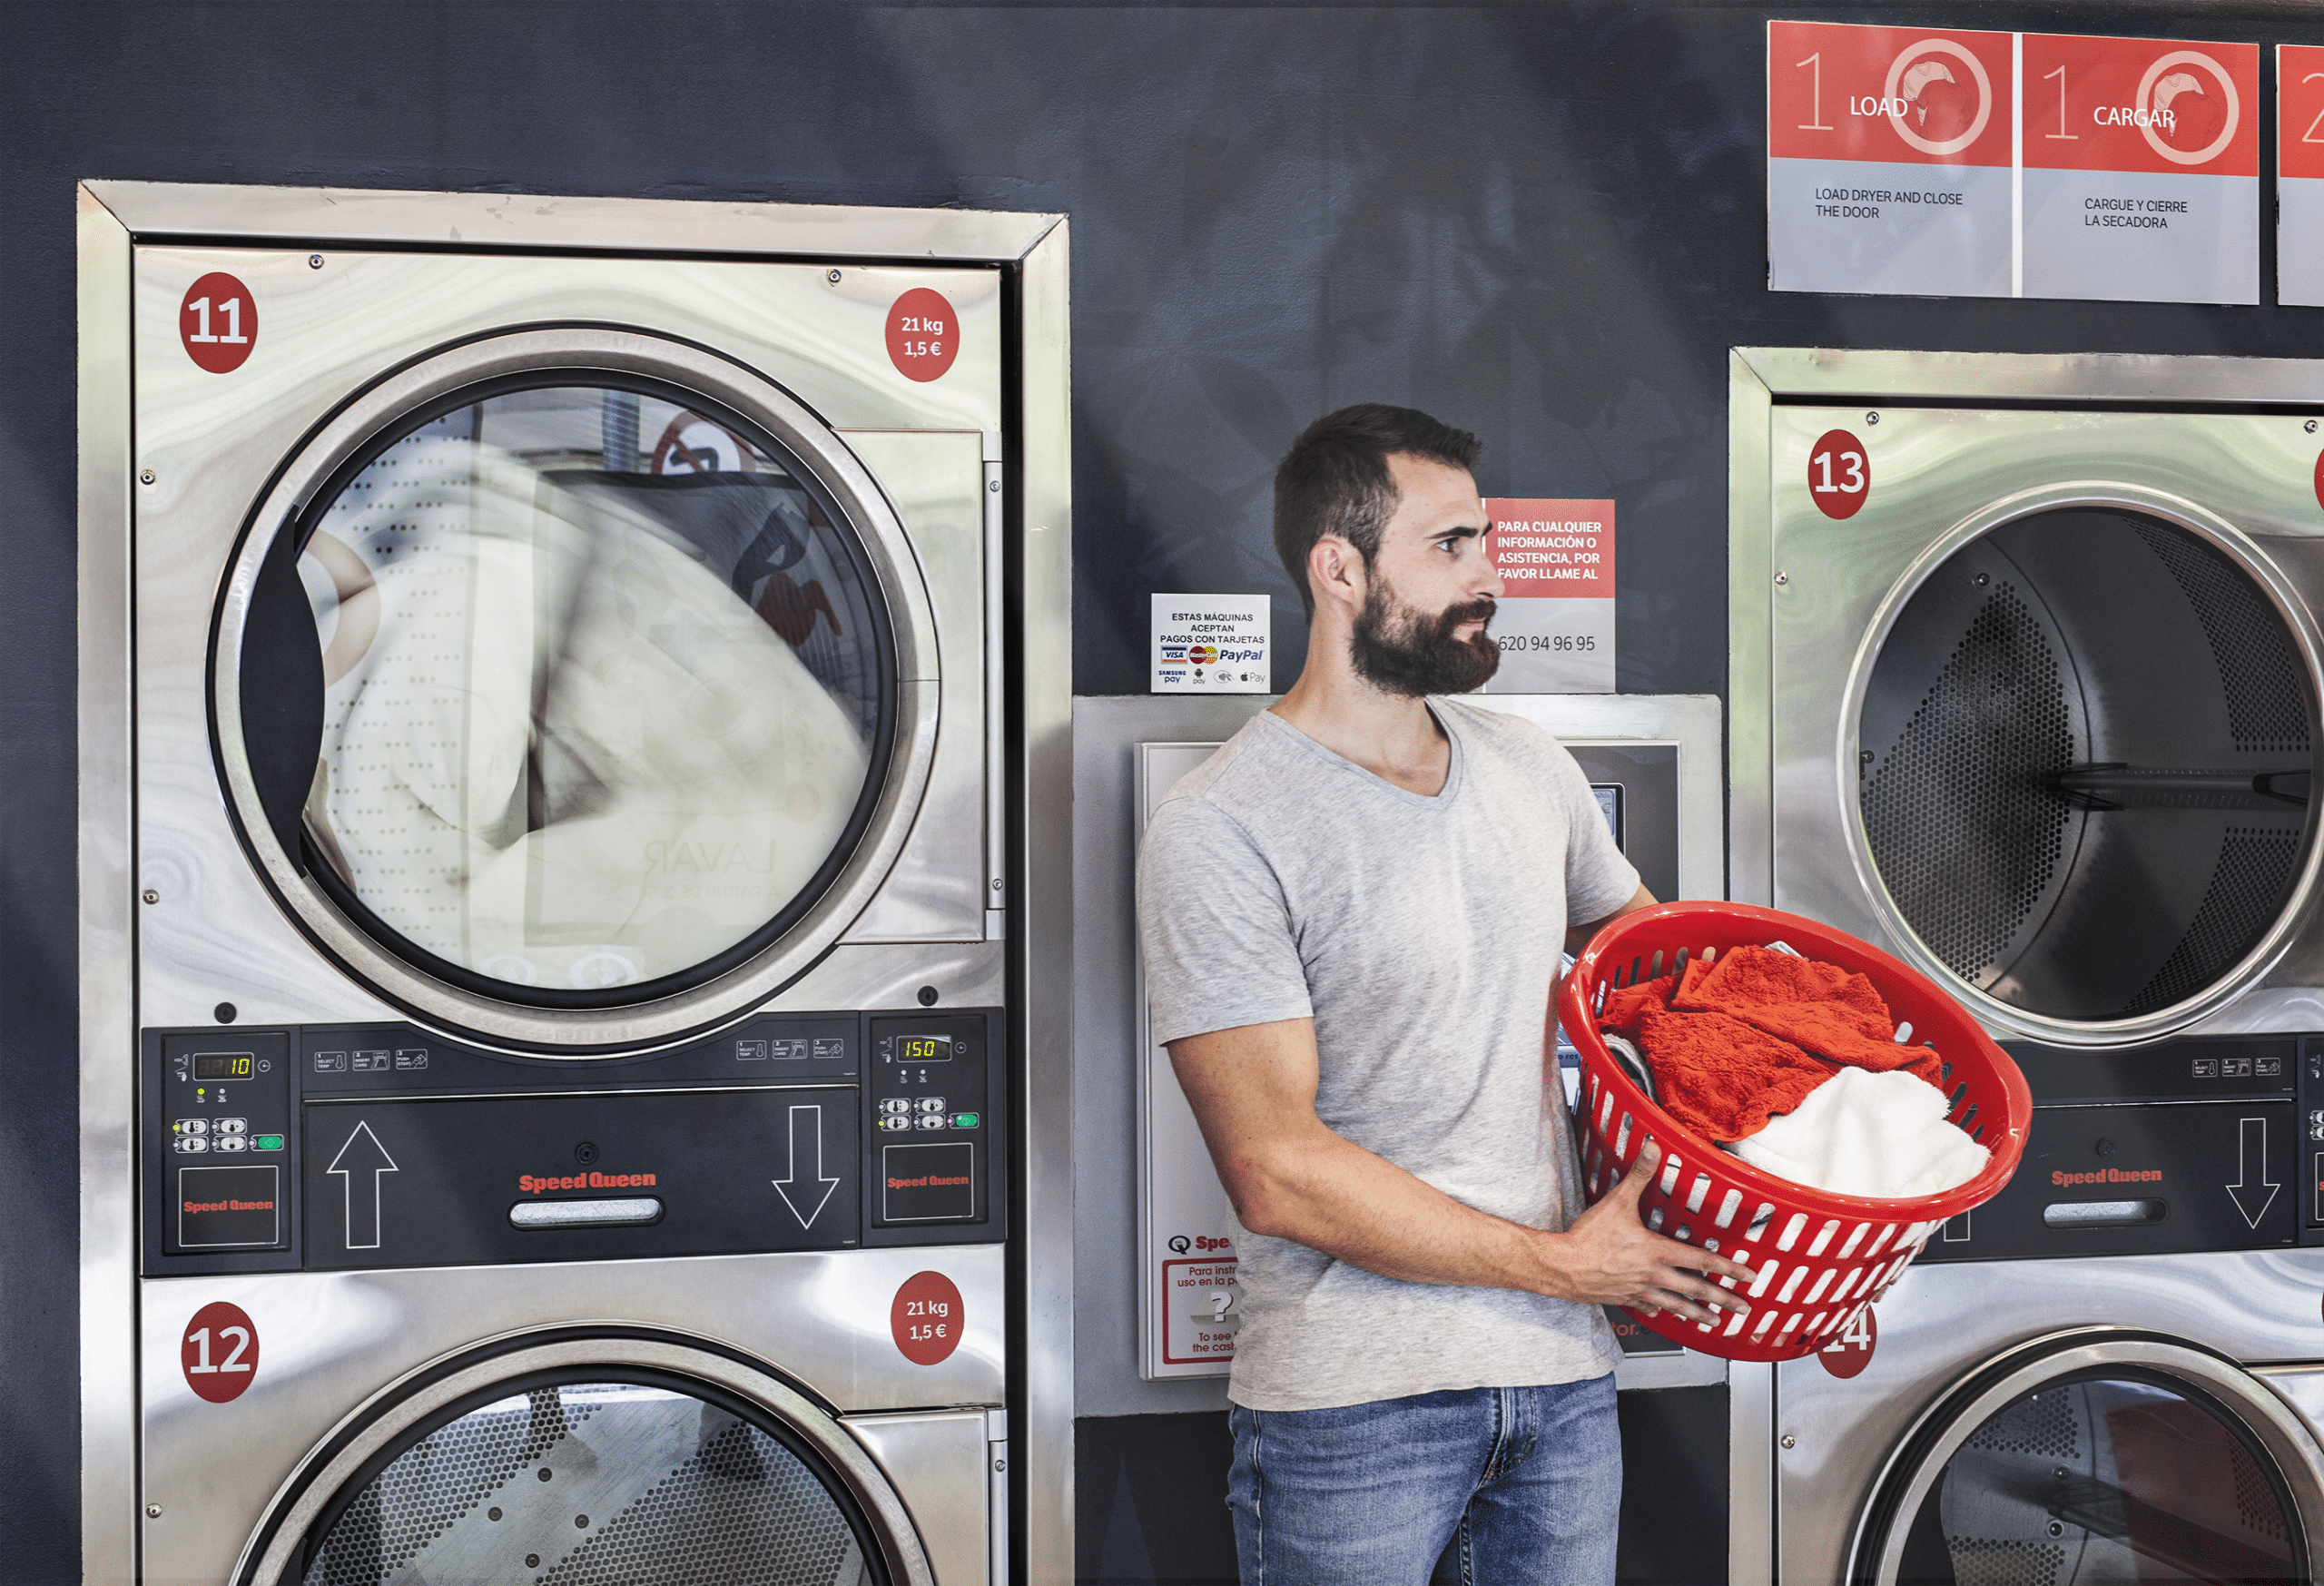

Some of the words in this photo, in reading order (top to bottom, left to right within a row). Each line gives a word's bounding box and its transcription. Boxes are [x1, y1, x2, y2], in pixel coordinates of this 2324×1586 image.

[1796, 52, 1834, 131] 1
[1850, 95, 1908, 117] LOAD
[2043, 64, 2079, 140] 1
[2302, 73, 2324, 143] 2
[2093, 106, 2175, 128] CARGAR
[1815, 188, 1849, 200] LOAD
[1852, 189, 1892, 202] DRYER
[1894, 192, 1921, 203] AND
[1923, 192, 1964, 205] CLOSE
[1815, 204, 1840, 217] THE
[1843, 206, 1880, 219] DOOR
[2084, 198, 2134, 211] CARGUE
[2136, 200, 2144, 211] Y
[2146, 200, 2188, 212] CIERRE
[2084, 214, 2100, 226] LA
[2102, 215, 2168, 229] SECADORA
[189, 297, 248, 344] 11
[901, 317, 921, 331] 21
[923, 317, 943, 336] kg
[904, 341, 927, 358] 1,5
[930, 341, 941, 356] €
[1814, 451, 1865, 493] 13
[1498, 521, 1530, 532] PARA
[1532, 521, 1602, 533] CUALQUIER
[1498, 535, 1584, 548] INFORMACIÓN
[1587, 537, 1597, 548] O
[1497, 552, 1572, 566] ASISTENCIA,
[1574, 552, 1600, 564] POR
[1498, 568, 1537, 579] FAVOR
[1540, 568, 1581, 579] LLAME
[1582, 568, 1599, 579] AL
[1171, 613, 1202, 621] ESTAS
[1204, 612, 1254, 622] MÁQUINAS
[1190, 624, 1235, 632] ACEPTAN
[1160, 635, 1193, 644] PAGOS
[1195, 635, 1216, 644] CON
[1217, 635, 1265, 644] TARJETAS
[1498, 635, 1527, 651] 620
[1531, 635, 1550, 651] 94
[1553, 635, 1572, 651] 96
[1576, 635, 1595, 651] 95
[1219, 649, 1263, 664] PayPal
[1249, 672, 1266, 685] Pay
[905, 1040, 935, 1057] 150
[231, 1058, 250, 1075] 10
[518, 1172, 587, 1194] Speed
[588, 1171, 656, 1188] Queen
[887, 1176, 927, 1189] Speed
[929, 1175, 969, 1186] Queen
[2052, 1168, 2106, 1187] Speed
[2107, 1167, 2162, 1183] Queen
[183, 1200, 228, 1214] Speed
[229, 1199, 273, 1210] Queen
[1196, 1236, 1234, 1252] Spe
[1189, 1266, 1212, 1276] Para
[1177, 1279, 1196, 1287] uso
[1198, 1278, 1212, 1286] en
[1215, 1276, 1225, 1286] la
[906, 1301, 925, 1316] 21
[929, 1300, 948, 1317] kg
[910, 1325, 932, 1342] 1,5
[935, 1324, 947, 1338] €
[1198, 1332, 1210, 1342] To
[1213, 1333, 1232, 1341] see
[188, 1325, 251, 1374] 12
[1193, 1343, 1209, 1353] the
